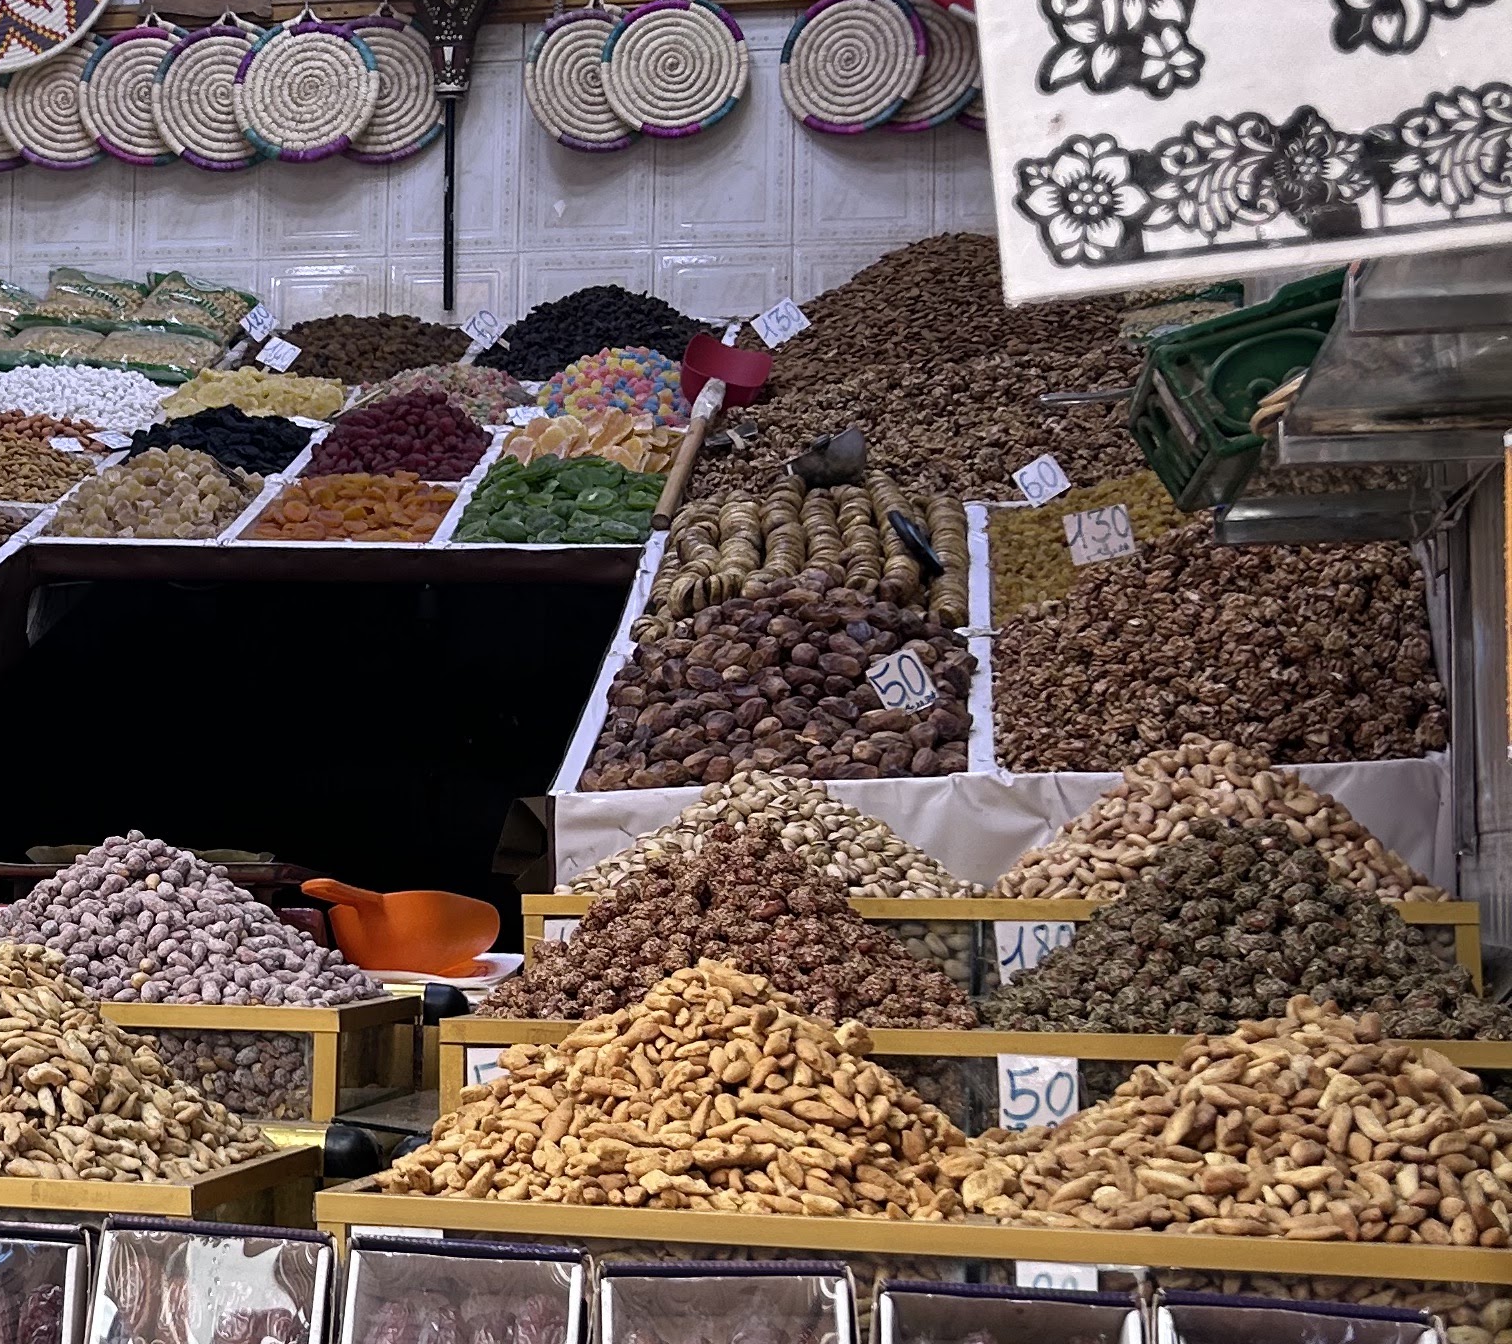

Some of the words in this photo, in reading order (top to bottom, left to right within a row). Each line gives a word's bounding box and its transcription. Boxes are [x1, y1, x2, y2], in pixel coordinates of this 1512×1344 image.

[758, 304, 802, 338] 130
[1019, 463, 1059, 499] 60
[1071, 505, 1128, 547] 130
[870, 654, 925, 706] 50
[1004, 1066, 1074, 1121] 50
